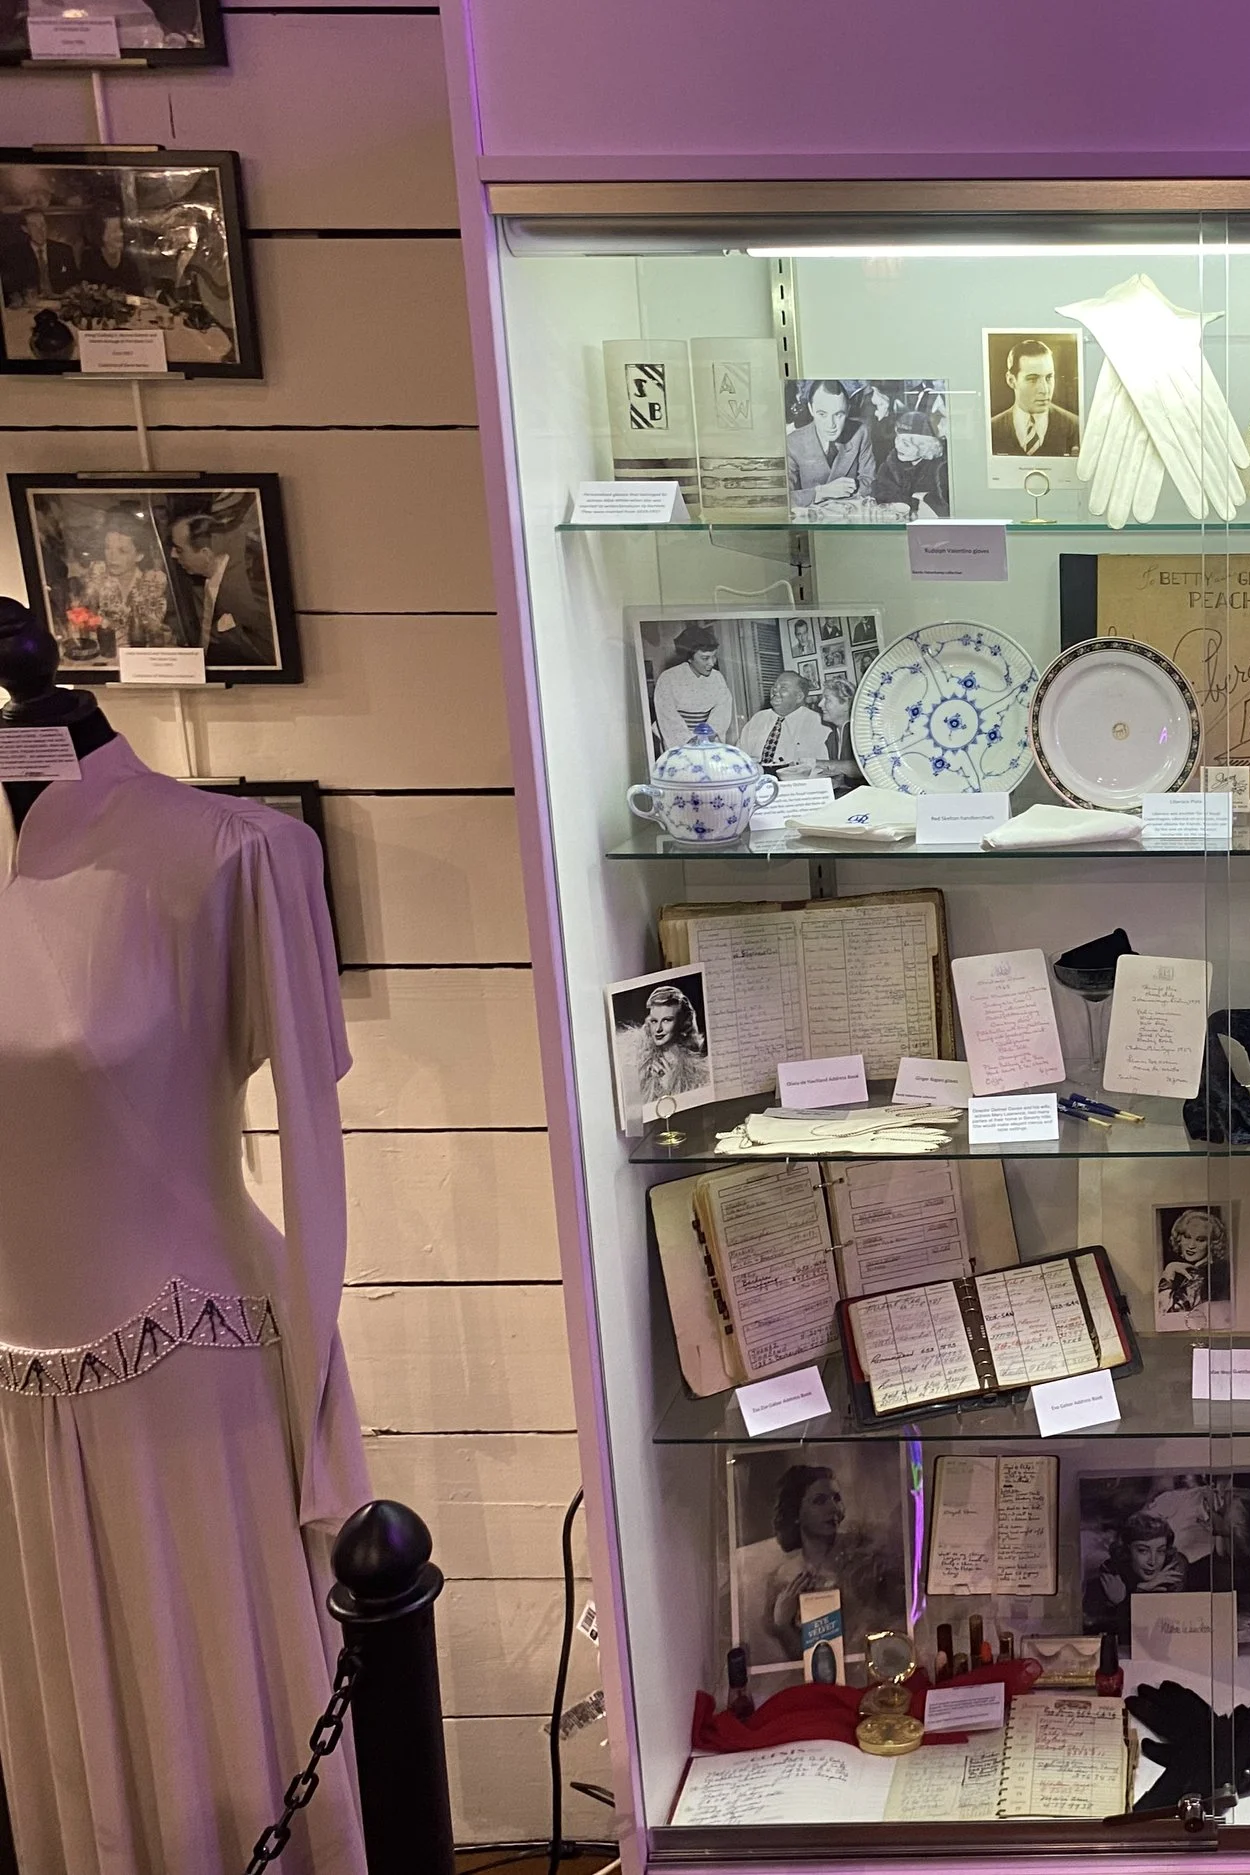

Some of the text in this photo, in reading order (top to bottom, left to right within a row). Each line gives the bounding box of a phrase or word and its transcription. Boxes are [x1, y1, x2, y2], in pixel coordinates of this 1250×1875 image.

[634, 379, 647, 397] S
[719, 373, 736, 394] A
[648, 402, 662, 420] B
[728, 399, 749, 419] W
[1159, 571, 1213, 586] BETTY
[808, 1621, 836, 1637] VELVET
[814, 1616, 829, 1628] EYE
